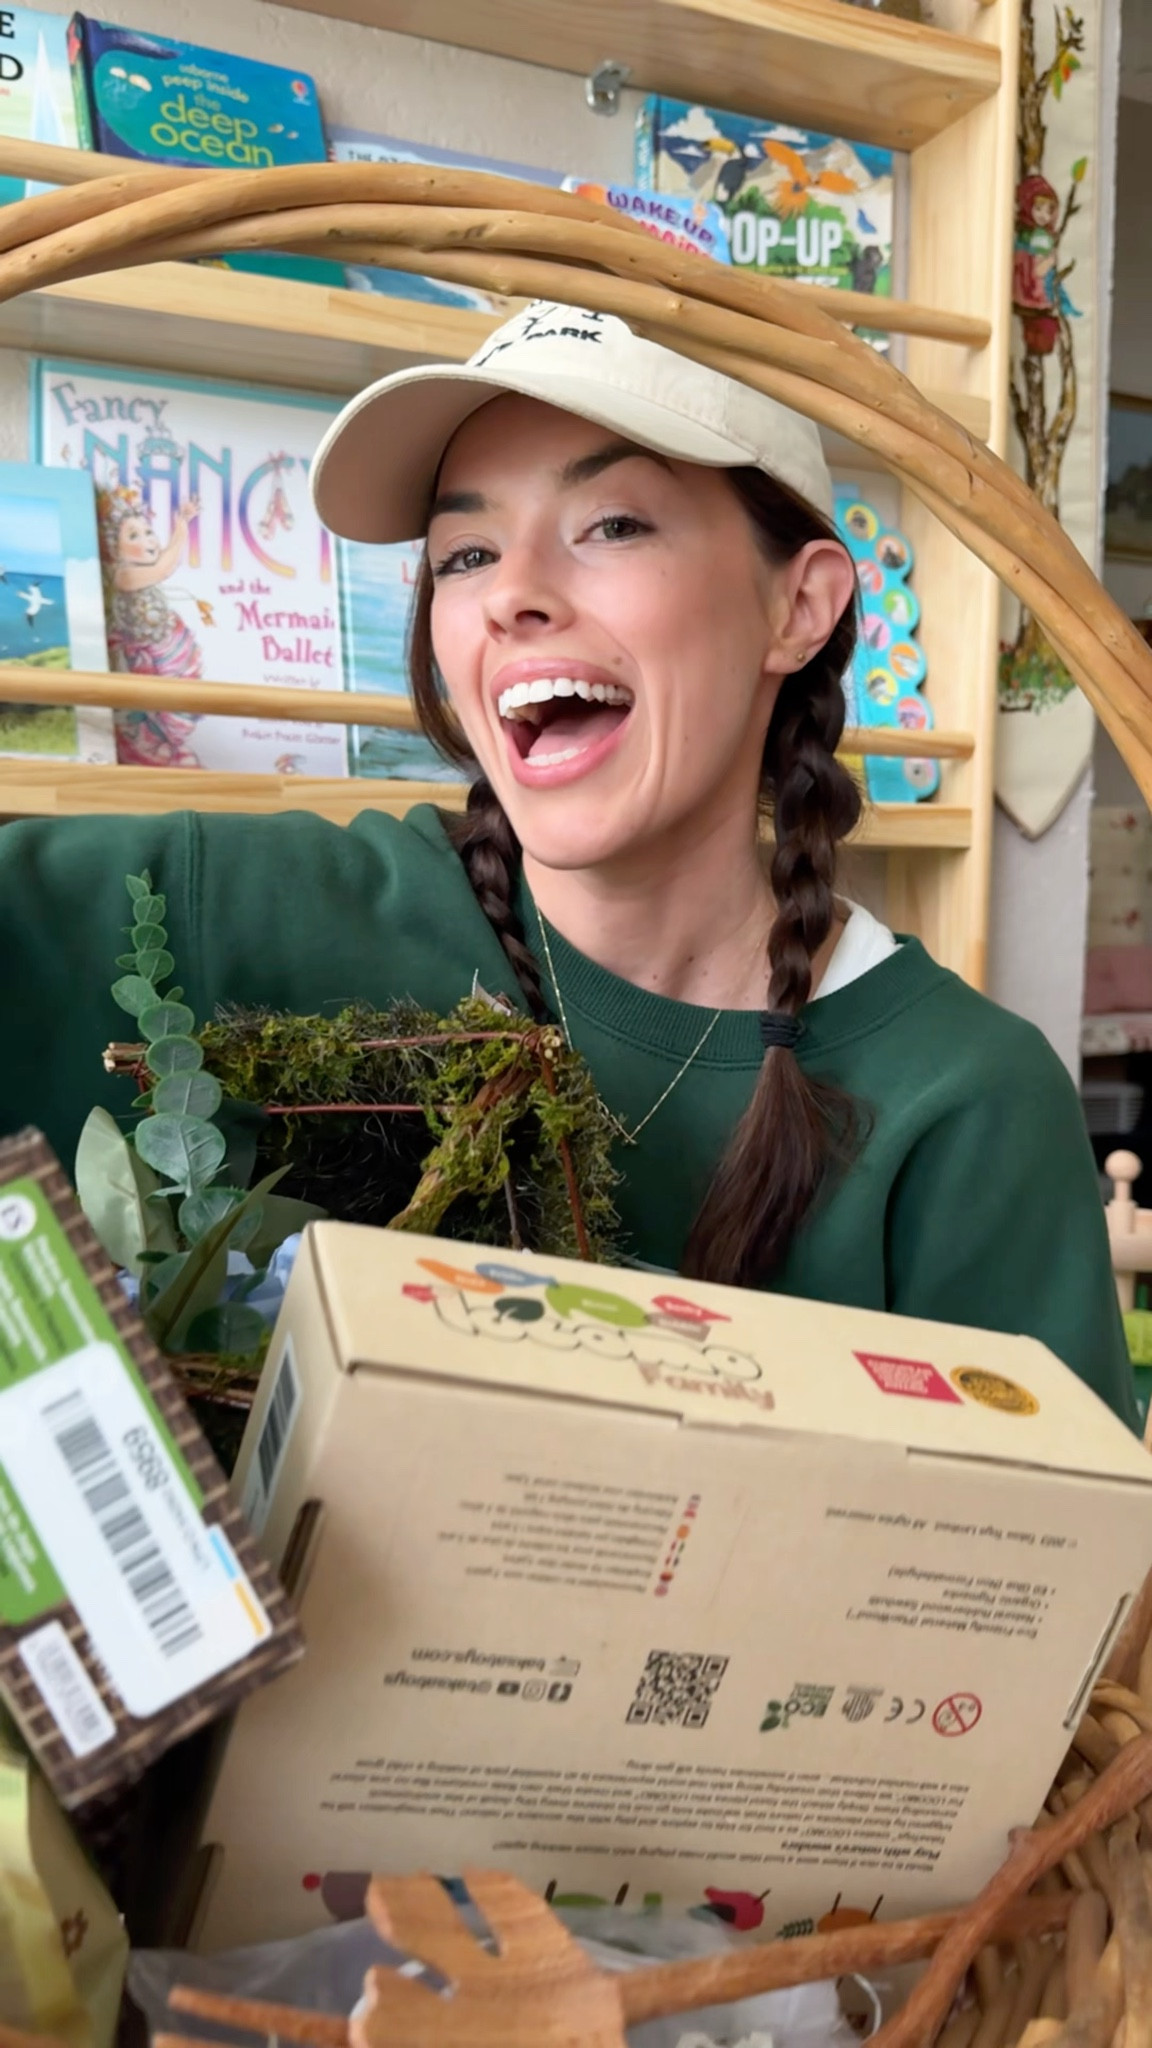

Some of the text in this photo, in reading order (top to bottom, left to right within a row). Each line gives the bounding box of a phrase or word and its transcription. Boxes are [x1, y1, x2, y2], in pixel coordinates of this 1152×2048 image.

[162, 75, 250, 104] peep inside
[160, 93, 259, 144] deep
[150, 122, 274, 168] ocean
[607, 190, 714, 244] WAKE UP
[724, 211, 842, 267] OP-UP
[51, 381, 168, 427] Fancy
[218, 577, 271, 594] and the
[261, 634, 333, 668] Ballet
[993, 1610, 1036, 1624] Natural
[998, 1595, 1042, 1610] Organic
[1016, 1627, 1038, 1640] Eco
[884, 1845, 911, 1859] with
